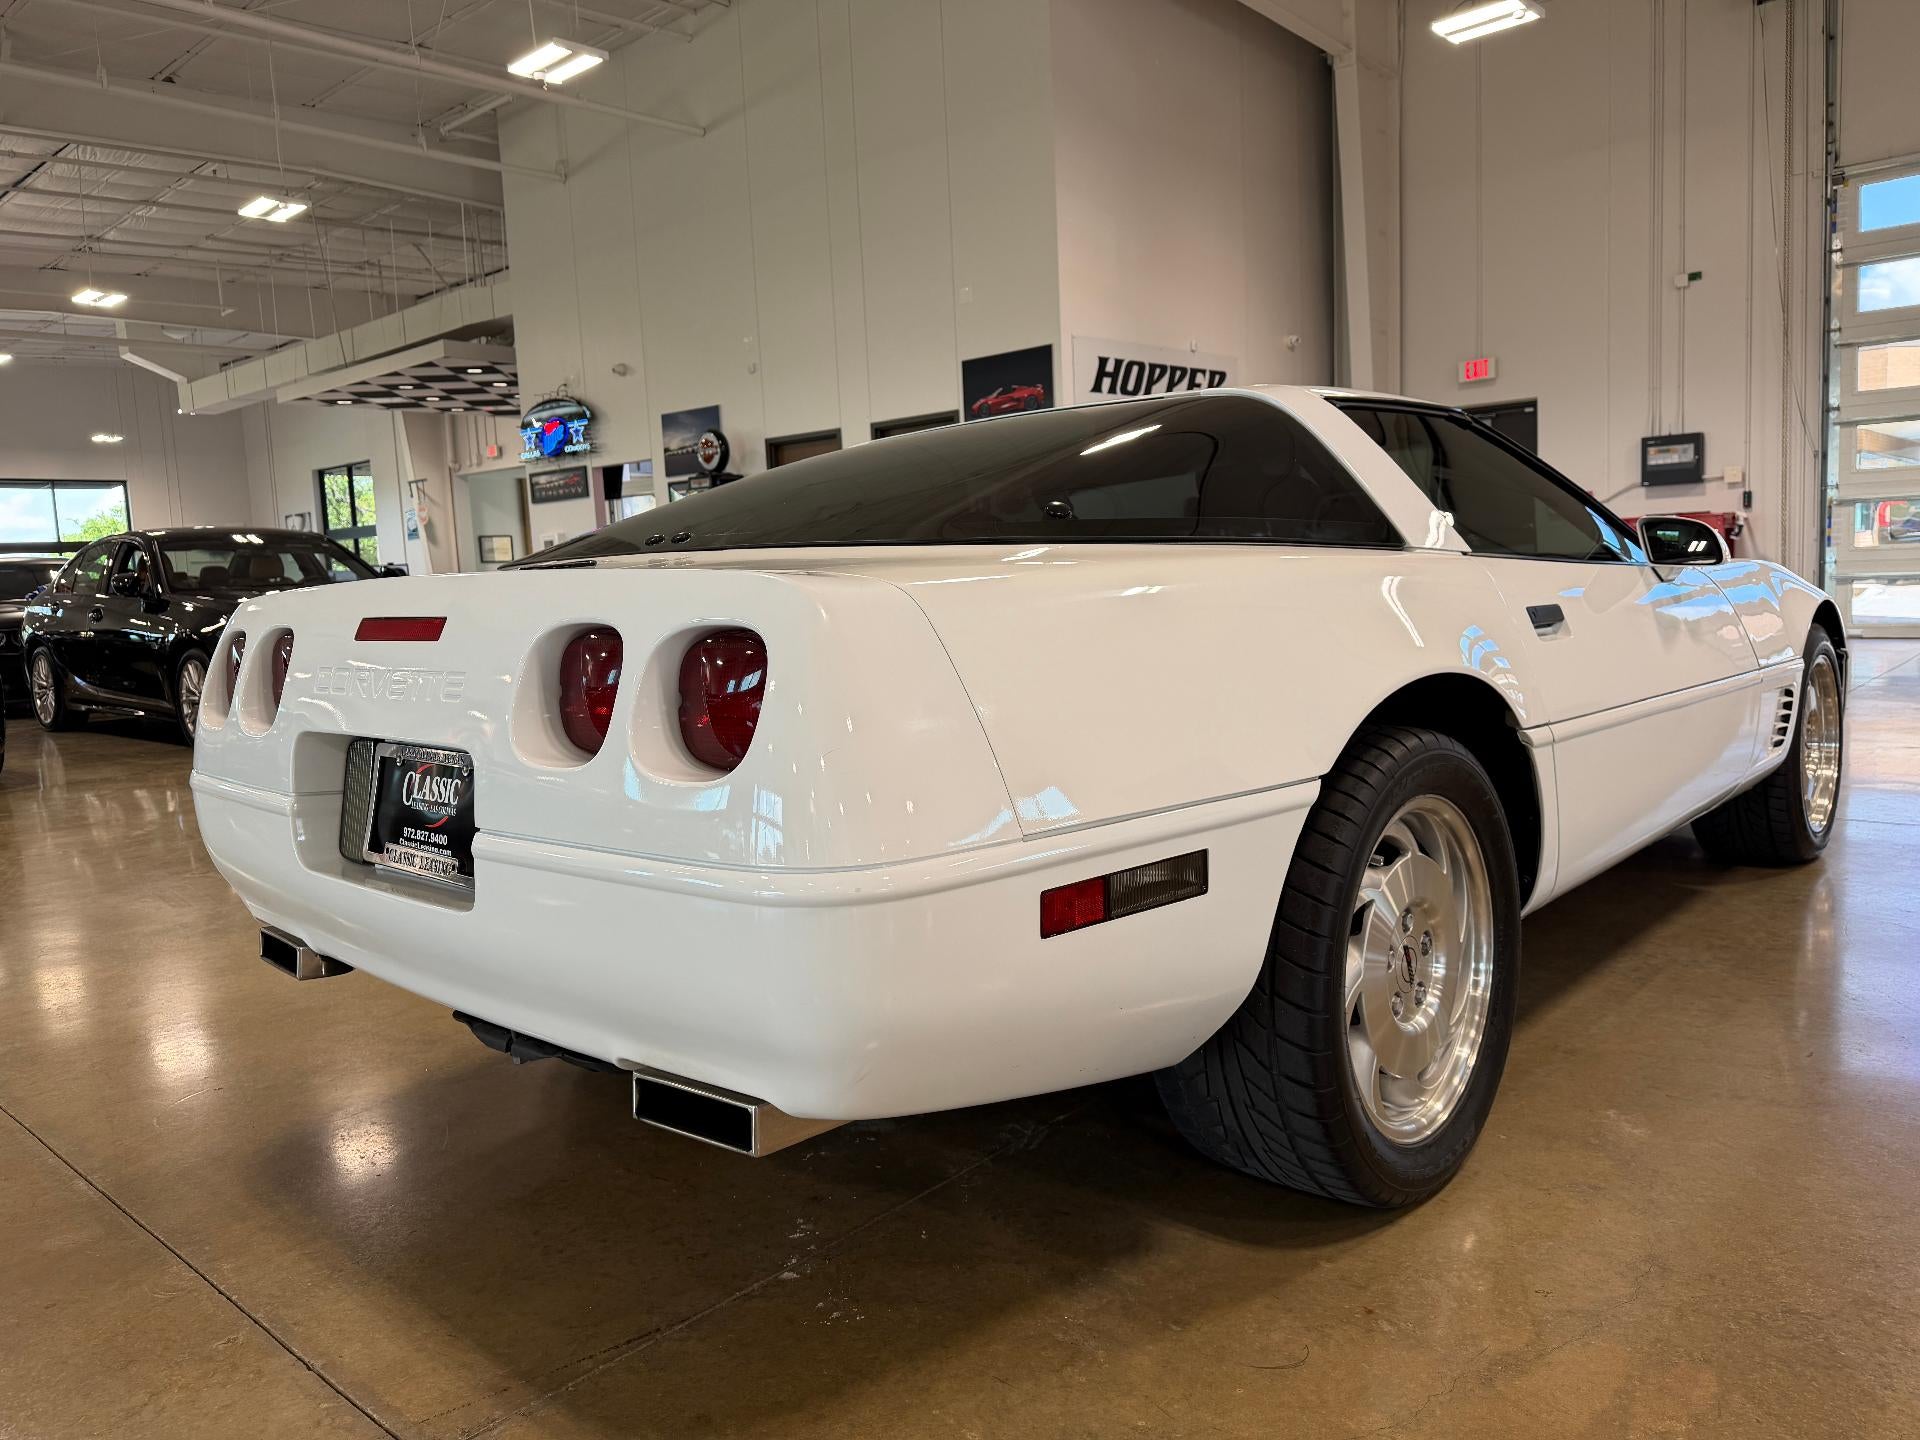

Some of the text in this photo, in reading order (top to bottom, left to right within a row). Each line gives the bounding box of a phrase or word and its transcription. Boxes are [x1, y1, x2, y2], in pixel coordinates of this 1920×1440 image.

[1464, 359, 1488, 380] EXIT
[313, 664, 467, 704] CORVETTE
[402, 771, 461, 806] CLASSIC
[403, 827, 448, 845] 972.827.9400
[388, 849, 418, 868] CLASSIC
